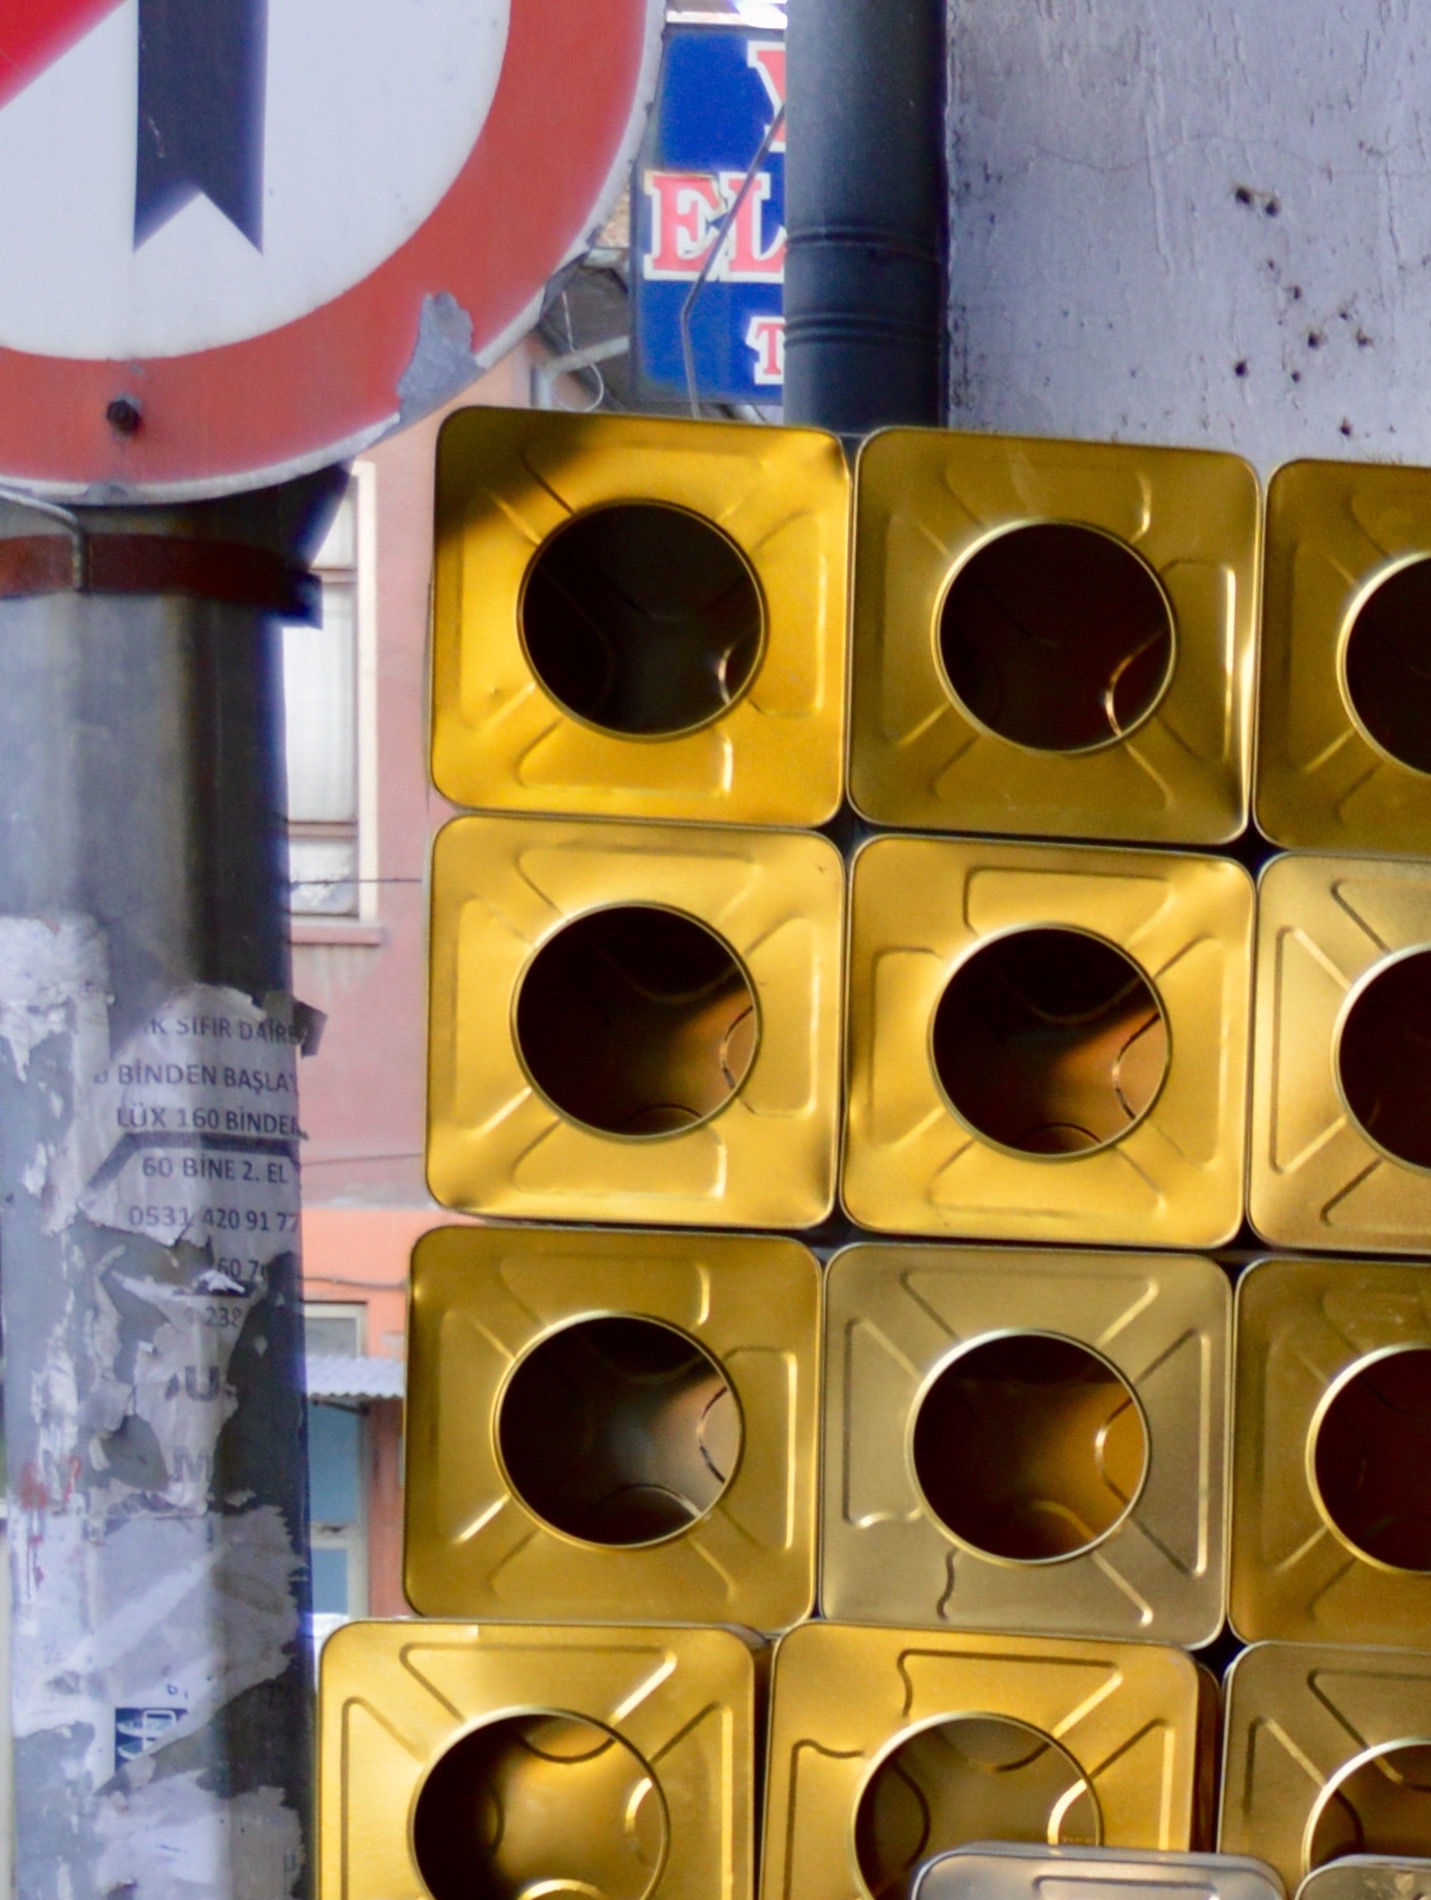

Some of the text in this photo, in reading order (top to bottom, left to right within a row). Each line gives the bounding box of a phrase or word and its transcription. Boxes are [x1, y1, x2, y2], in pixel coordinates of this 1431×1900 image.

[118, 1059, 217, 1087] BİNDEN
[117, 1103, 167, 1128] LÜX
[177, 1108, 220, 1129] 160
[142, 1156, 289, 1184] 60 BİNE 2. EL
[129, 1206, 189, 1227] 0531
[203, 1208, 240, 1229] 420
[246, 1211, 269, 1232] 91
